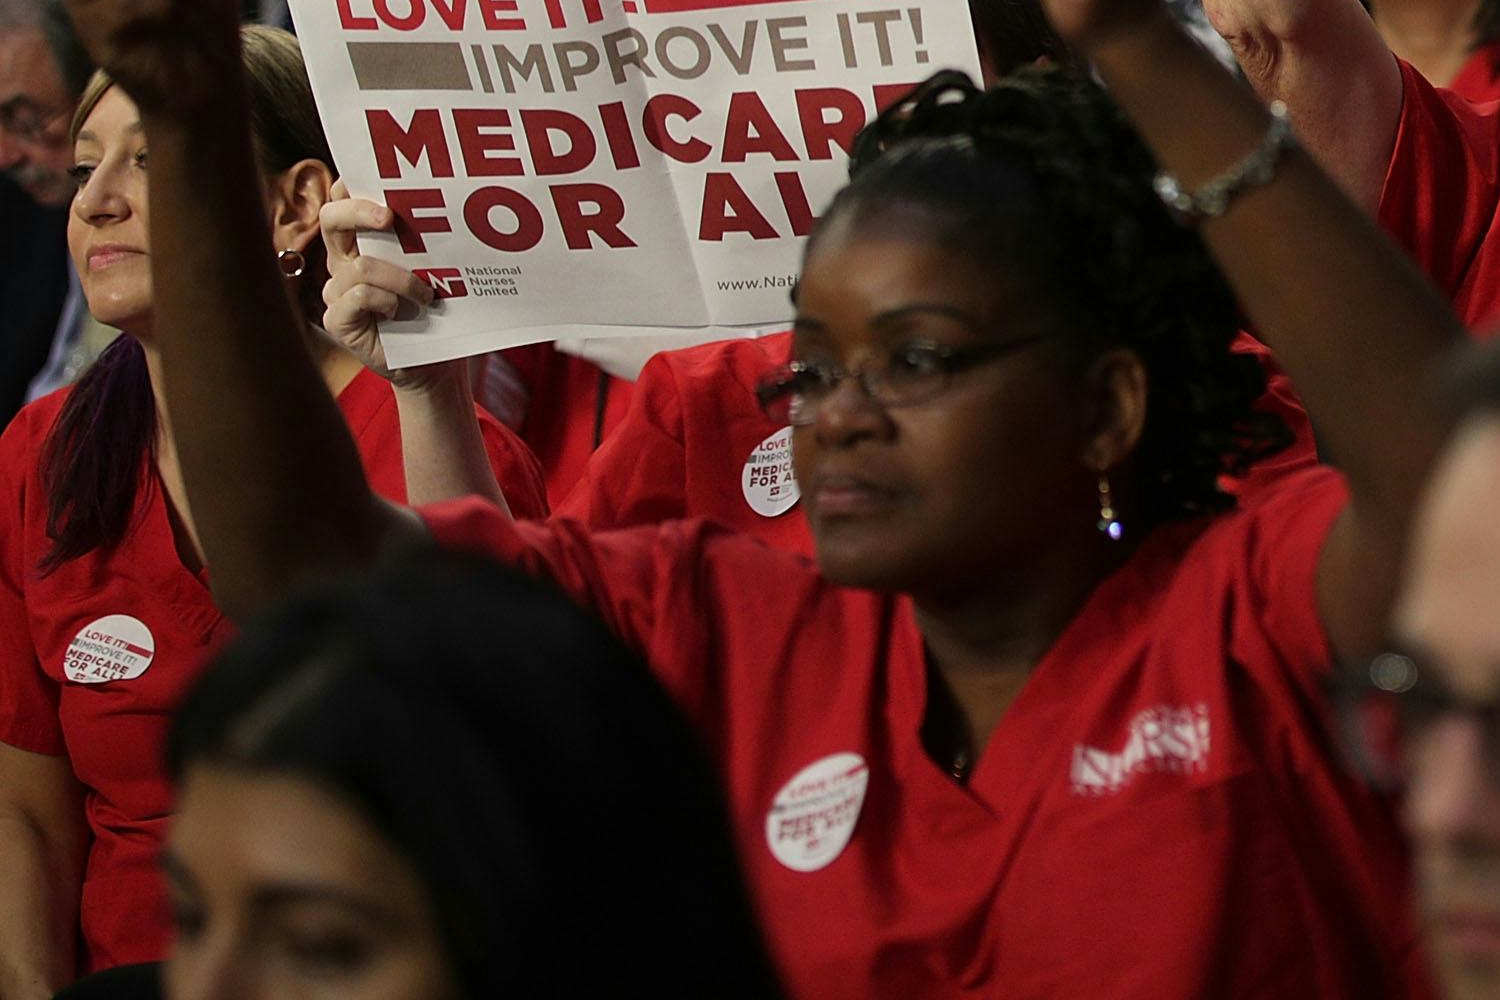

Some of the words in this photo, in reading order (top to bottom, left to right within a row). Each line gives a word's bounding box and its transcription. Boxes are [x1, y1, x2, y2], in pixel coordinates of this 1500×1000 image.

[471, 16, 816, 93] IMPROVE
[836, 7, 929, 68] IT!
[365, 83, 922, 178] MEDICAR
[384, 183, 638, 254] FOR
[698, 171, 823, 241] AL
[465, 266, 521, 276] National
[469, 277, 515, 287] Nurses
[473, 287, 518, 297] United
[760, 438, 786, 451] LOVE
[757, 449, 793, 463] IMPRO
[750, 476, 778, 488] FOR
[85, 630, 112, 644] LOVE
[79, 640, 123, 659] IMPROVE
[67, 649, 129, 675] MEDICARE
